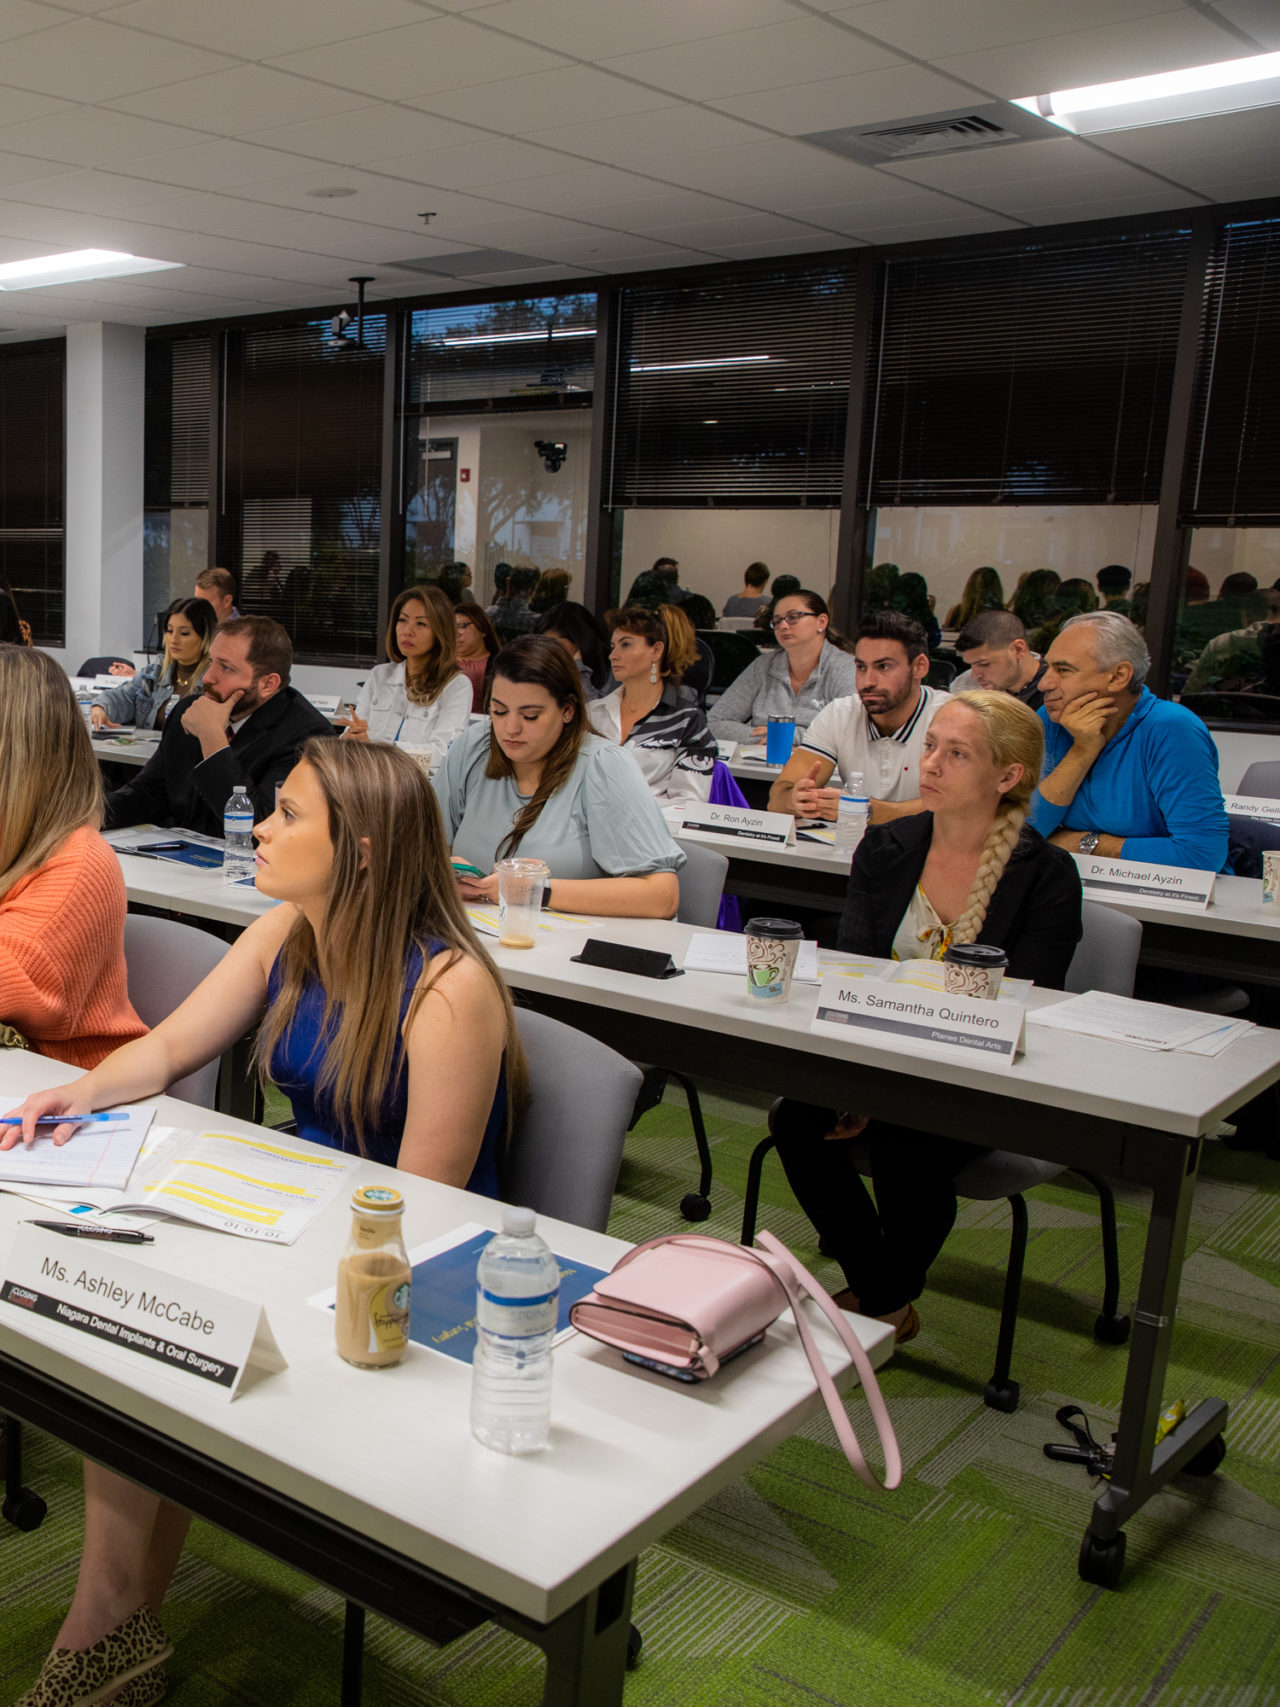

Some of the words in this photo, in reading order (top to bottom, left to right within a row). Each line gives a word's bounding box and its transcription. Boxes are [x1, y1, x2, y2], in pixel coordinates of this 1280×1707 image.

[1230, 802, 1259, 812] Randy
[710, 812, 721, 820] Dr.
[724, 814, 740, 823] Ron
[741, 816, 763, 827] Ayzin
[1090, 865, 1105, 875] Dr.
[1109, 867, 1151, 881] Michael
[1152, 874, 1183, 886] Ayzin
[1139, 887, 1164, 897] Dentistry
[1181, 893, 1199, 901] Finest
[838, 989, 861, 1005] Ms.
[866, 994, 935, 1018] Samantha
[938, 1007, 1000, 1030] Quintero
[931, 1030, 958, 1043] Planes
[959, 1035, 985, 1047] Dental
[985, 1039, 1002, 1051] Arts
[40, 1256, 69, 1284] Ms.
[74, 1269, 135, 1309] Ashley
[137, 1291, 216, 1336] McCabe
[56, 1302, 90, 1324] Niagara
[89, 1315, 119, 1338] Dental
[118, 1325, 157, 1351] Implants
[156, 1341, 166, 1354] &
[165, 1343, 187, 1362] Oral
[186, 1352, 225, 1377] Surgery
